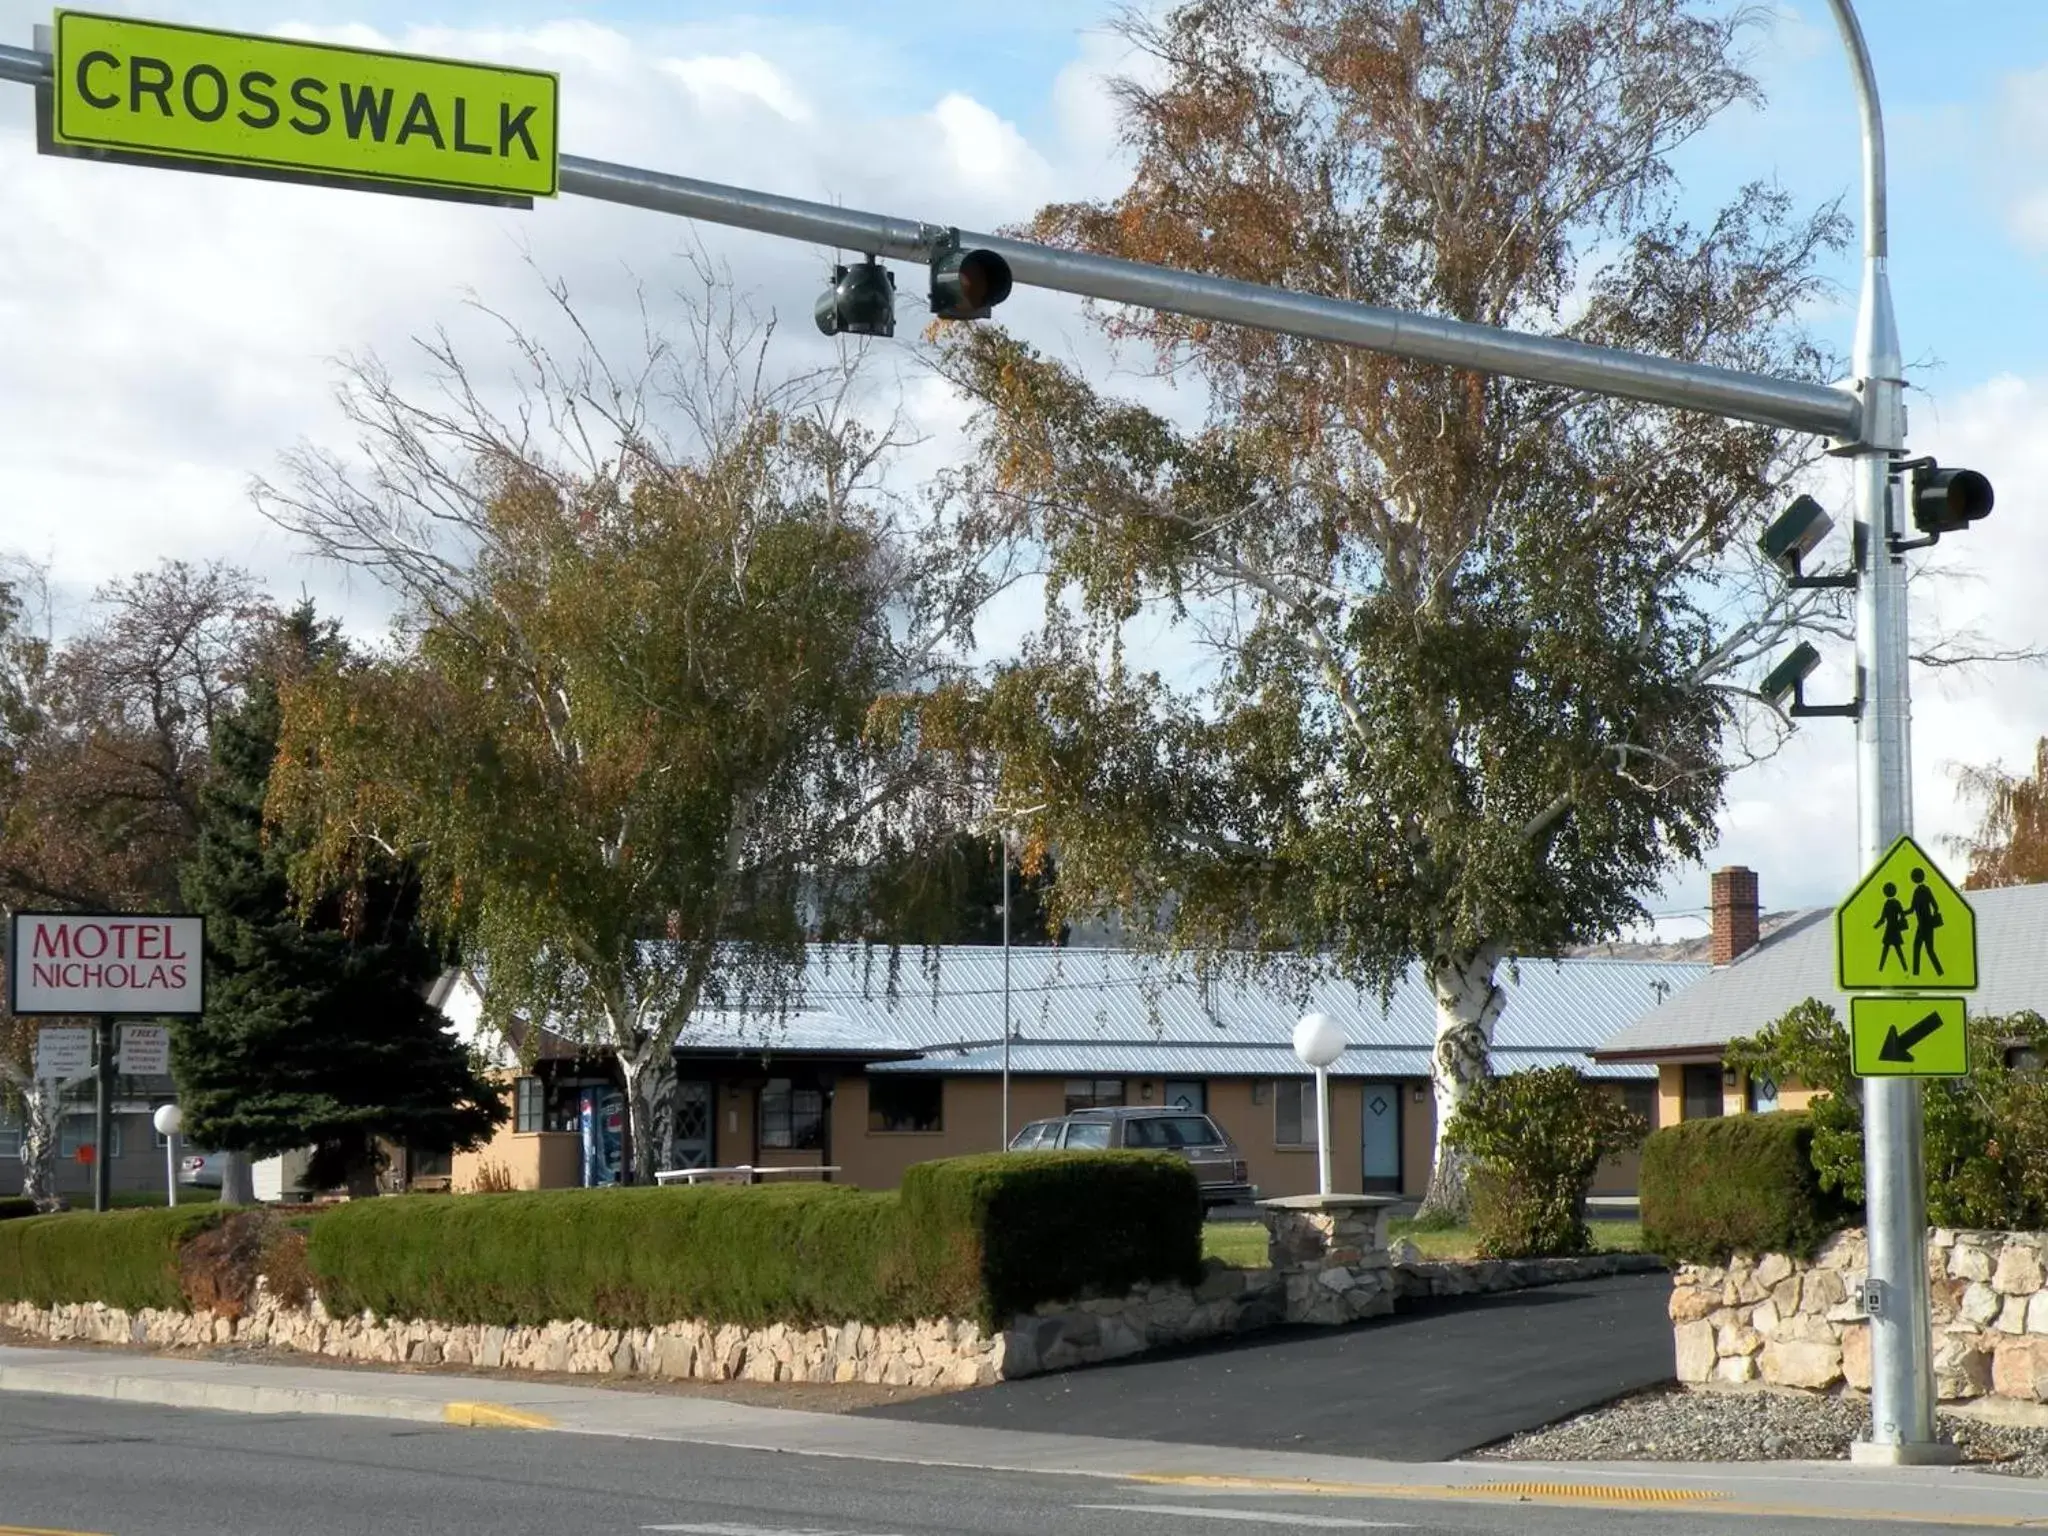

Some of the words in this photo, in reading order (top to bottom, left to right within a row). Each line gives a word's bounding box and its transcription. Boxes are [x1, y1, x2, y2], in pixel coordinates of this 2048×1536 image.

[76, 50, 540, 161] CROSSWALK
[32, 923, 187, 960] MOTEL
[32, 963, 187, 989] NICHOLAS
